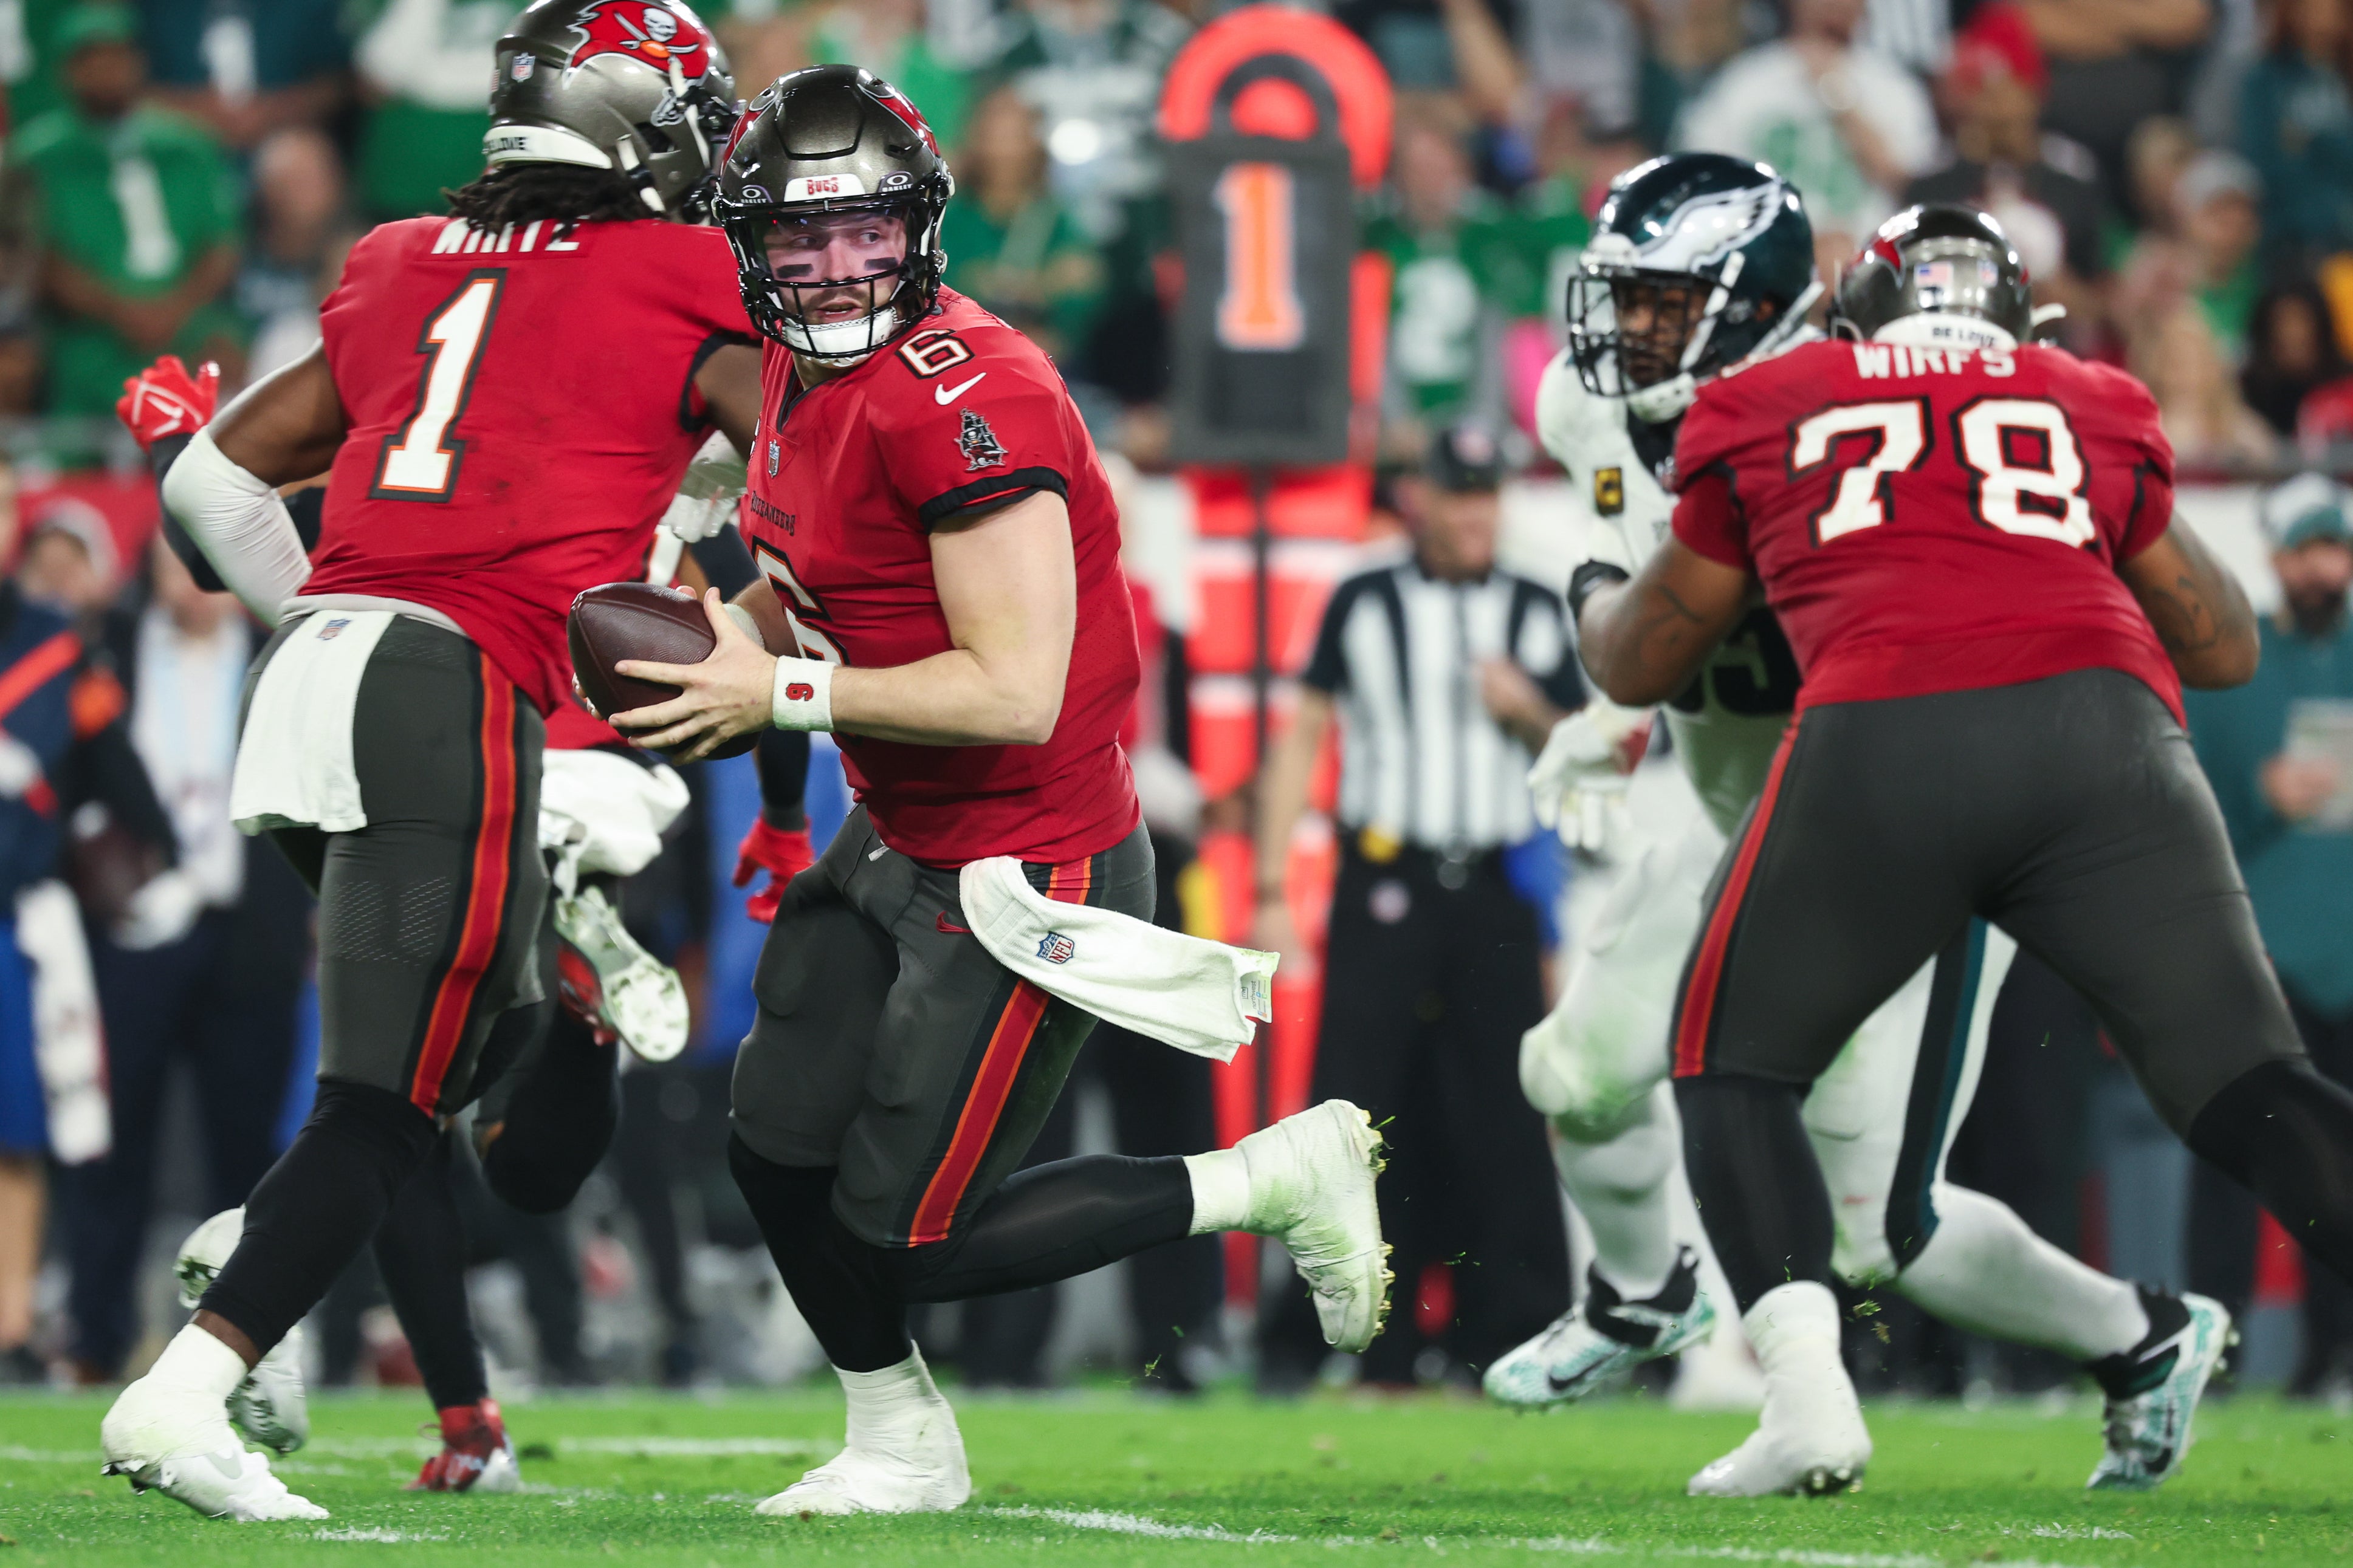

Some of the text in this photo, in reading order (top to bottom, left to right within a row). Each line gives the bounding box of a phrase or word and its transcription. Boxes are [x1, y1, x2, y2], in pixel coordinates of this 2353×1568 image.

[882, 183, 913, 193] OAKLEY
[1212, 162, 1307, 352] 1
[895, 328, 975, 379] 6
[1853, 344, 2016, 378] WIRFS
[368, 268, 509, 503] 1
[1785, 394, 2101, 550] 78
[751, 490, 795, 536] BUCCANEERS
[1048, 940, 1073, 963] NFL
